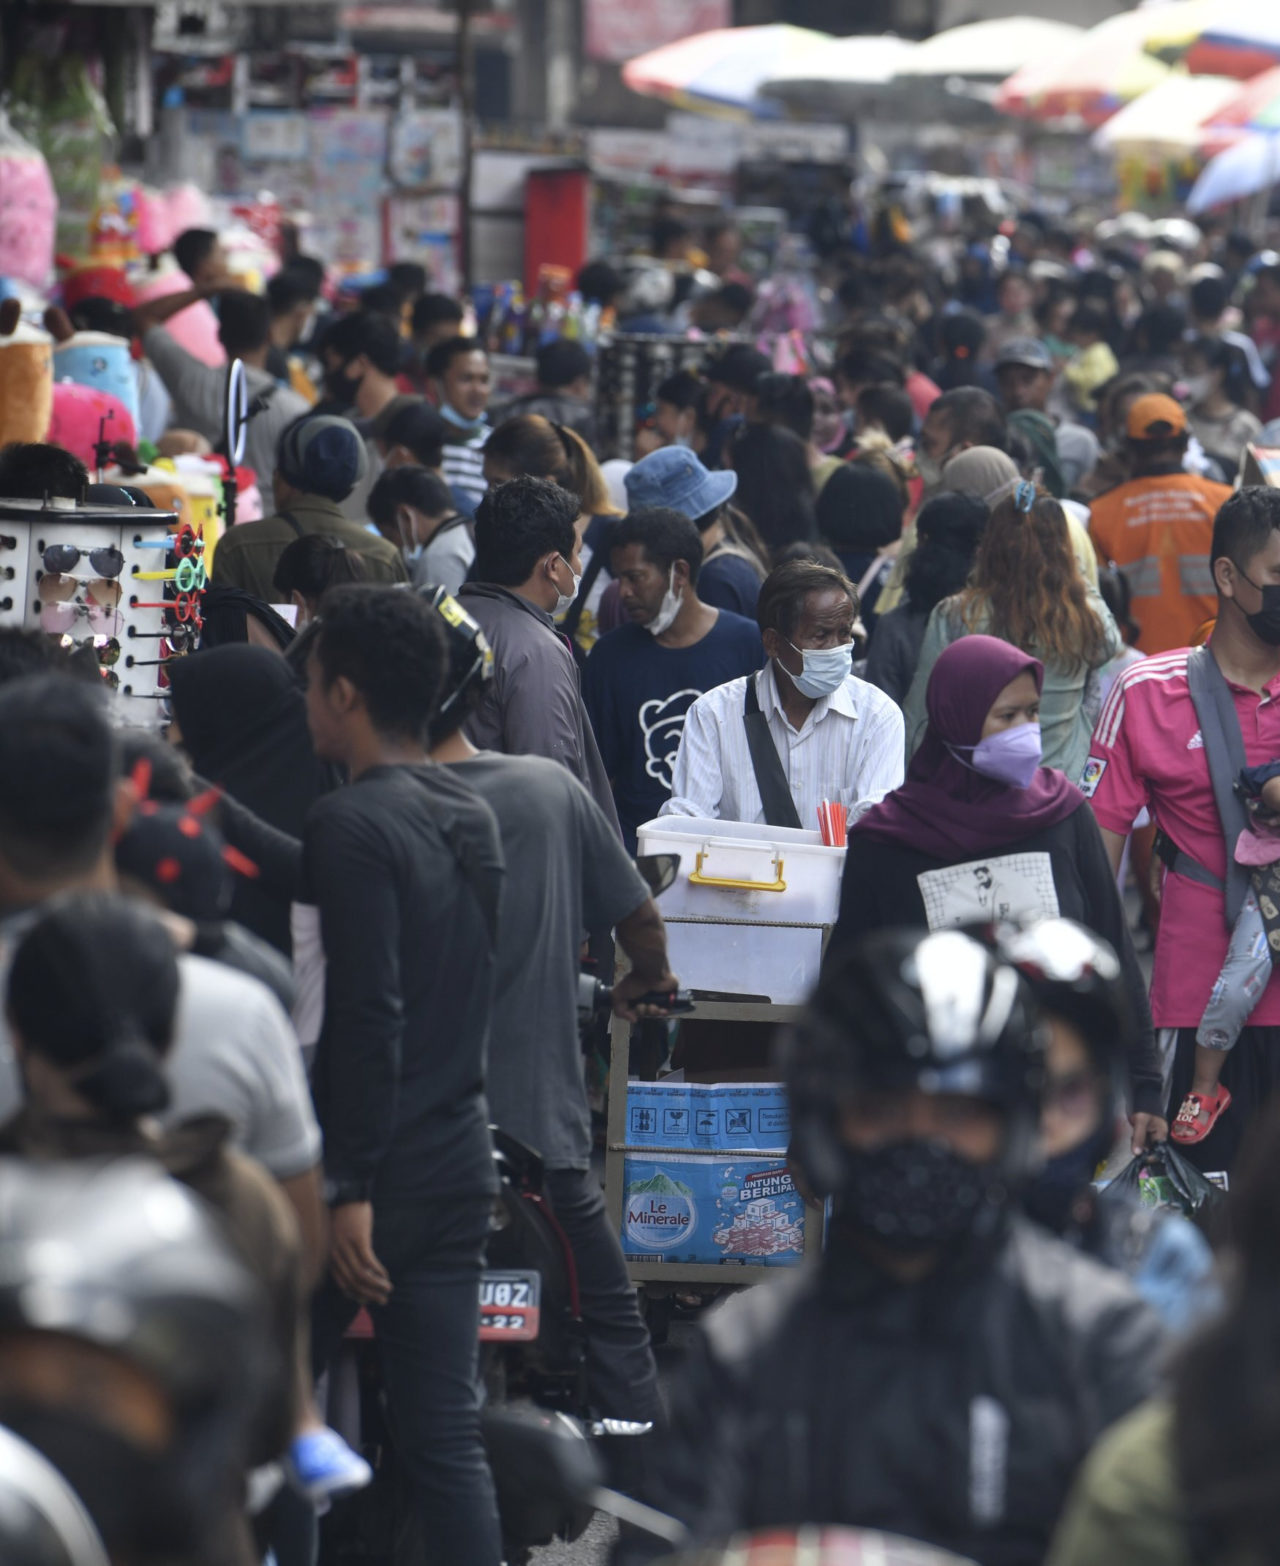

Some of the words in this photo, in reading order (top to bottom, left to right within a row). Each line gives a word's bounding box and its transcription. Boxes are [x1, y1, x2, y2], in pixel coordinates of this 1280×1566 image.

[744, 1174, 792, 1189] UNTUNG
[650, 1200, 667, 1213] Le
[628, 1211, 690, 1225] Minerale
